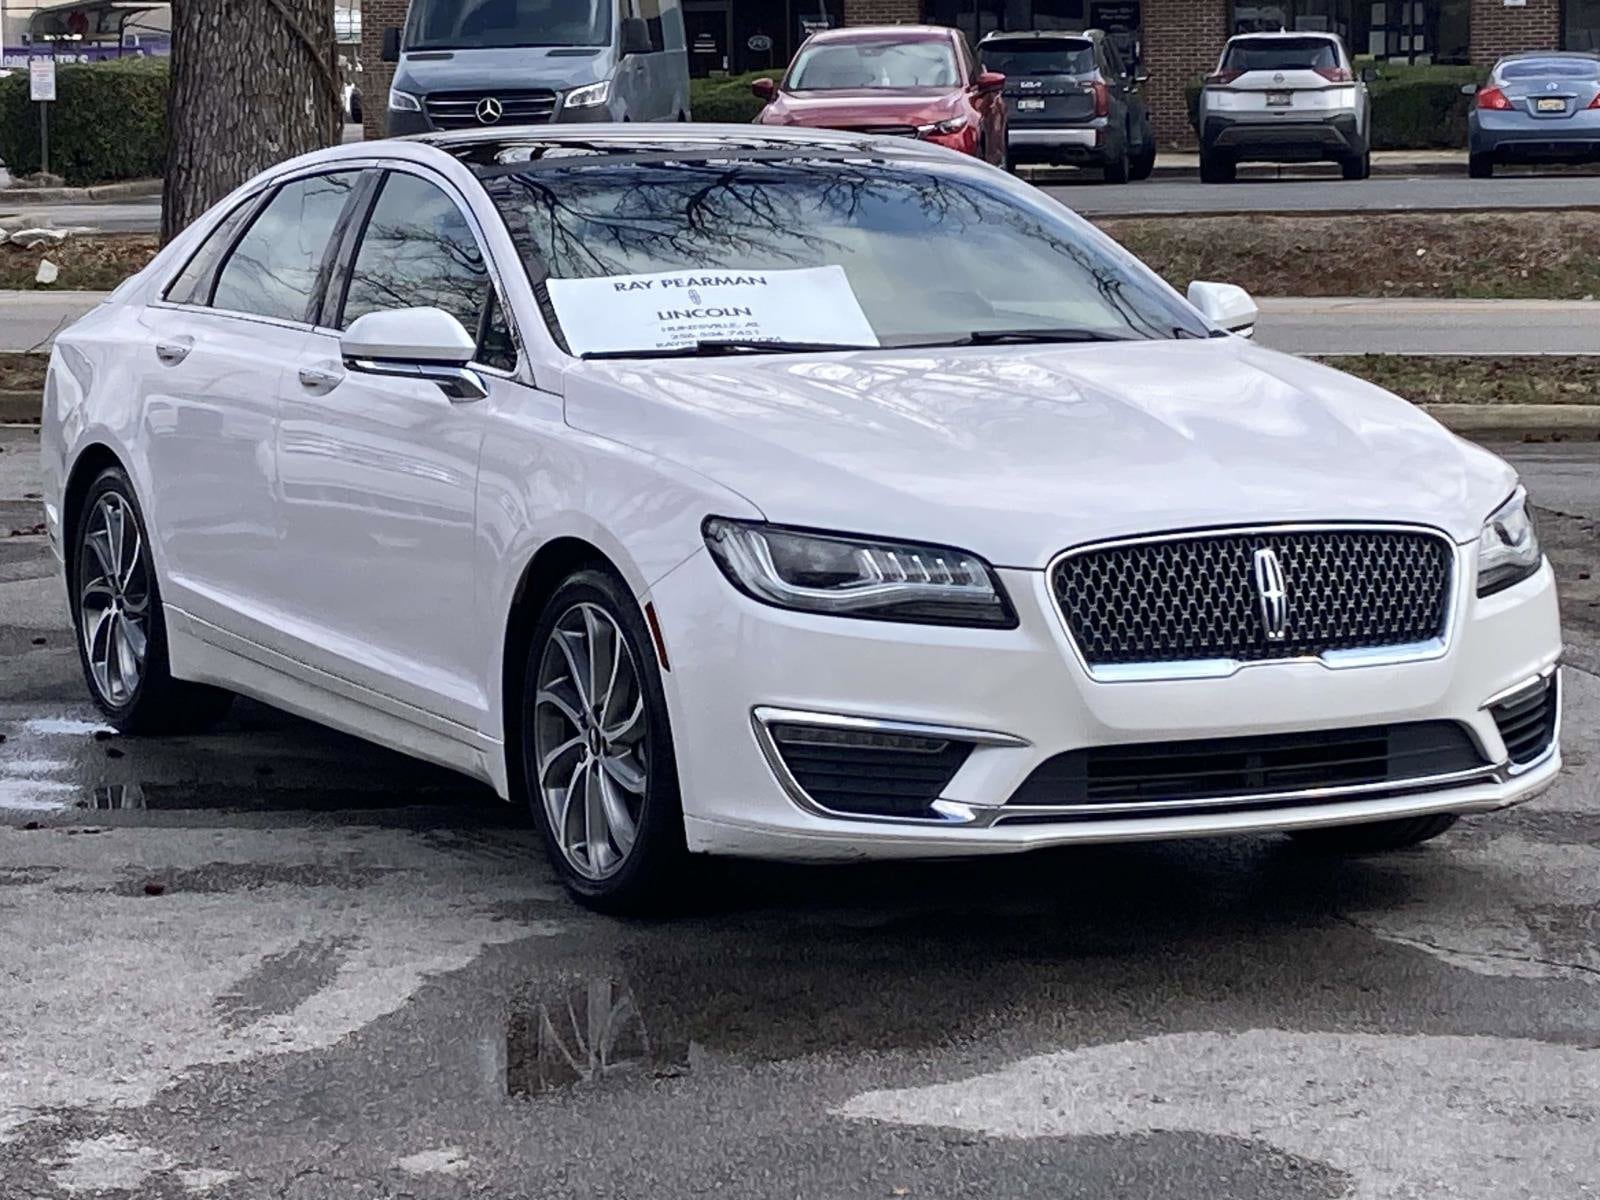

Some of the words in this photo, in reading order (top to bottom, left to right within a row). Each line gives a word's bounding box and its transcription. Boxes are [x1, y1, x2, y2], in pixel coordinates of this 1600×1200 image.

[614, 279, 654, 292] RAY
[661, 276, 767, 288] PEARMAN
[657, 306, 753, 321] LINCOLN
